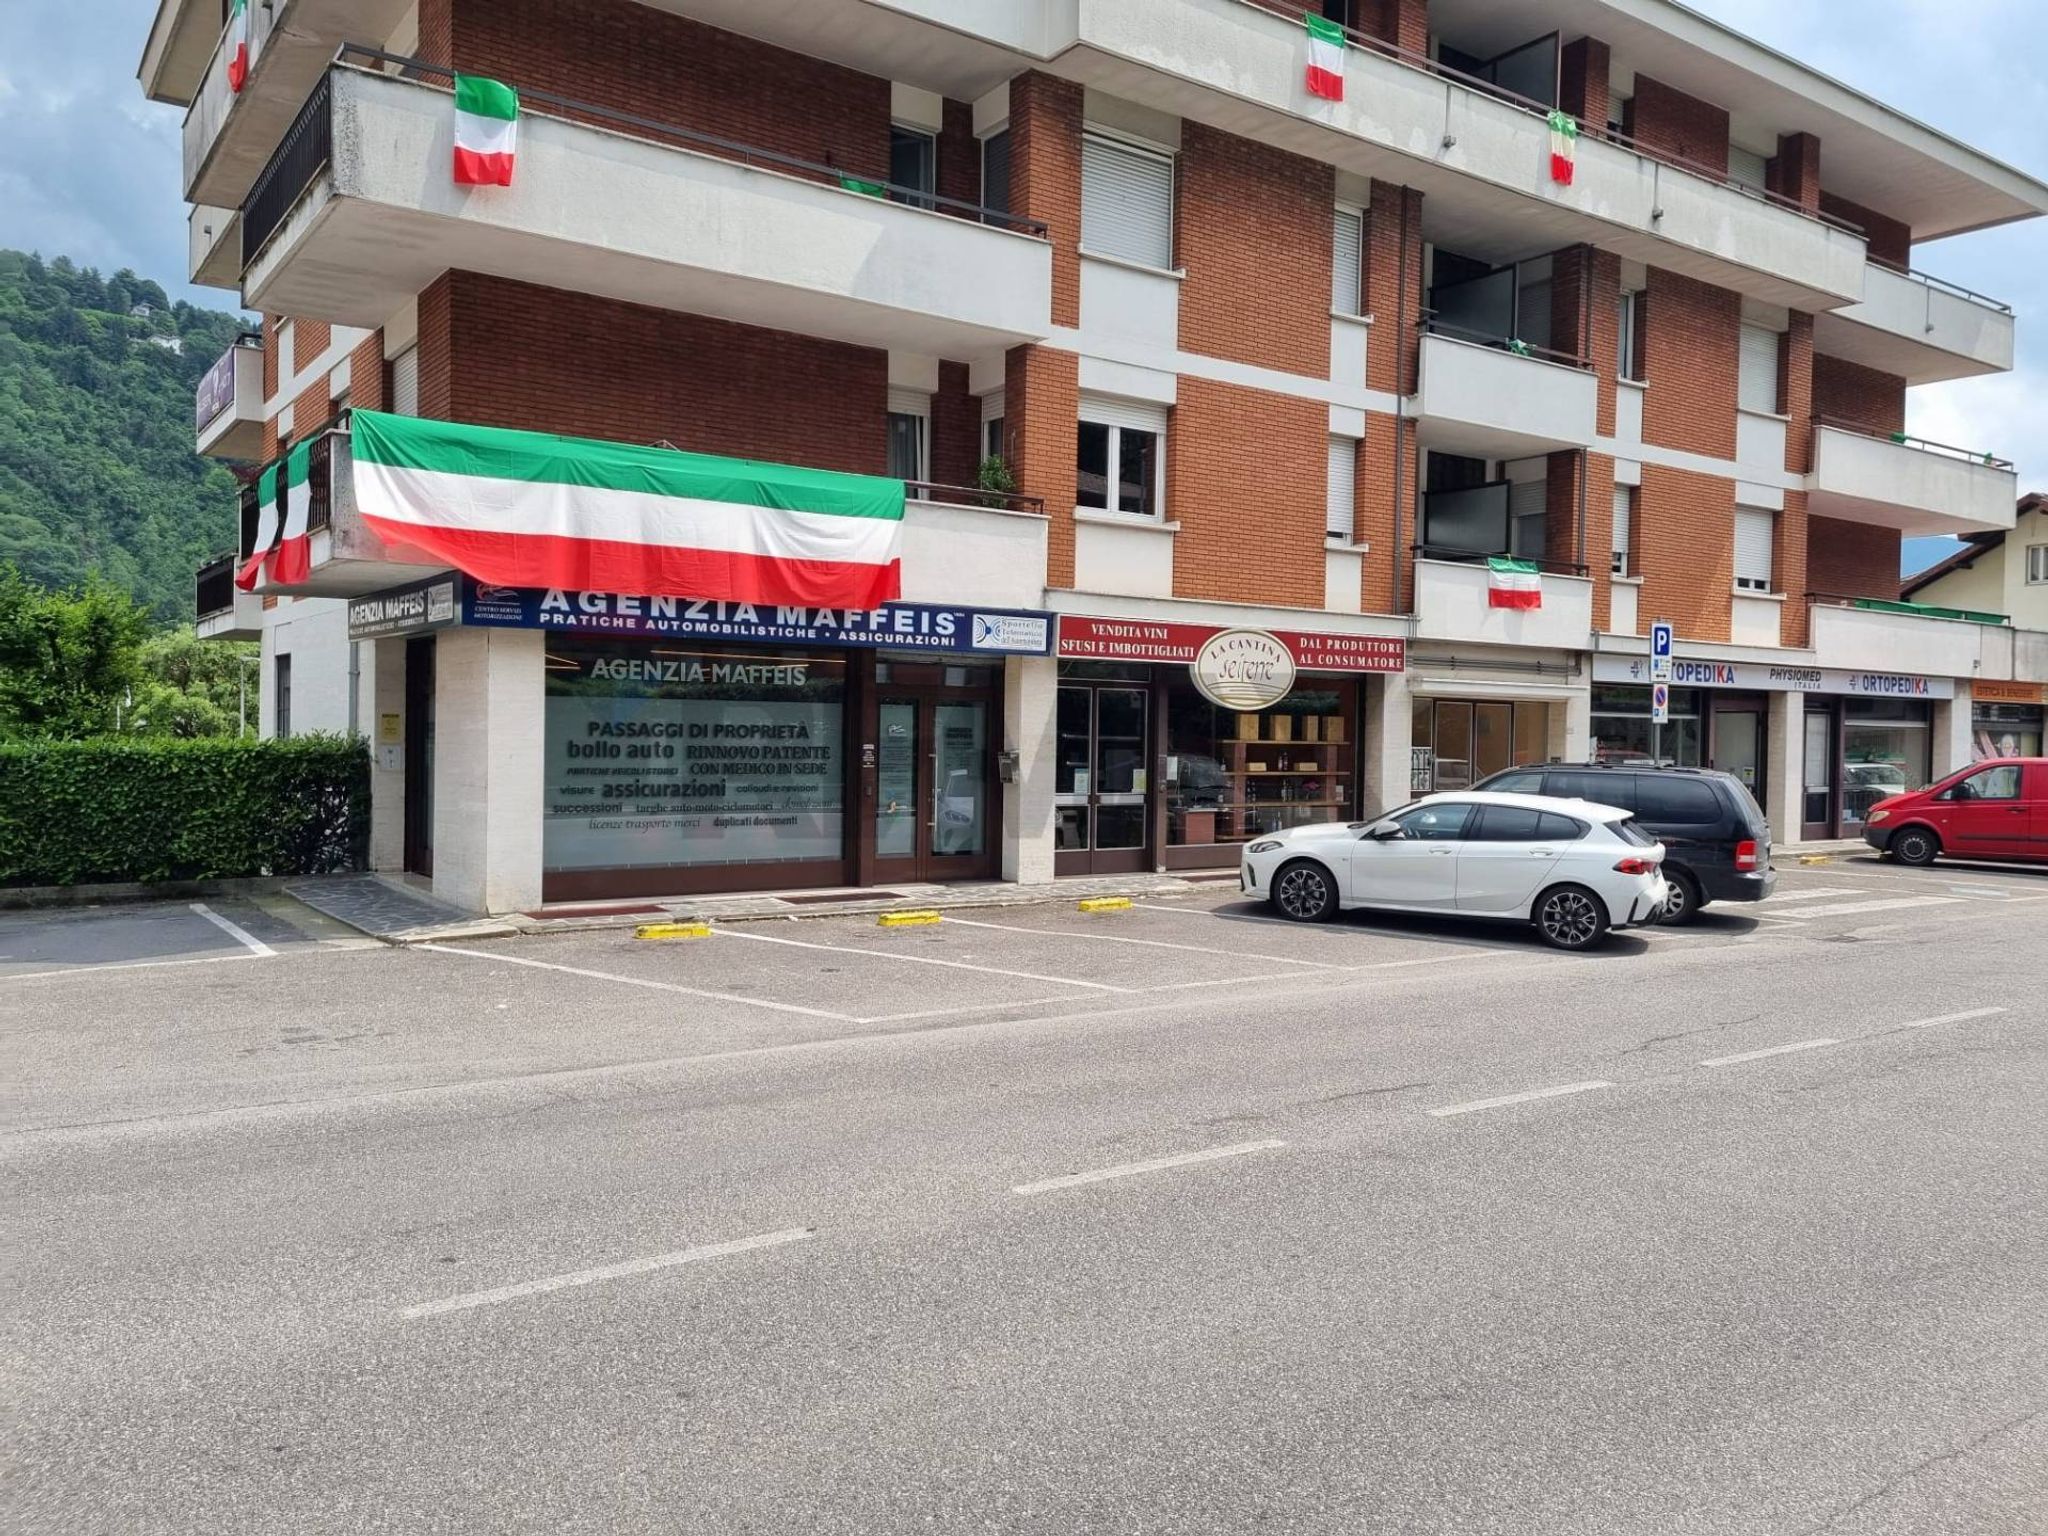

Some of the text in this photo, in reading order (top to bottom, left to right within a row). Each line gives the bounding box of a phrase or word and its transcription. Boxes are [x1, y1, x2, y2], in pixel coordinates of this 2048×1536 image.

[350, 601, 384, 625] AGENZIA
[386, 590, 424, 619] MAFFEIS
[540, 589, 955, 635] AGENZIA MAFFEIS
[540, 613, 955, 647] PRATICHE AUTOMOBILISTICHE ASSICURAZIONI
[1091, 624, 1168, 640] VENDITA VINI
[1061, 639, 1194, 658] SFUSI E IMBOTTIGLIATI
[1300, 637, 1401, 654] DAL PRODUTTORE
[1657, 631, 1667, 652] P
[1210, 639, 1281, 663] LA CANTINA
[1300, 654, 1401, 668] AL CONSUMATORE
[590, 658, 807, 687] AGENZIA MAFFEIS
[1770, 668, 1822, 682] PHYSIOMED
[1794, 682, 1821, 690] ITALIA
[1862, 674, 1928, 694] ORTOPEDIKA
[588, 721, 810, 739] PASSAGGI DI PROPRIETÀ
[567, 740, 674, 759] bollo auto
[686, 746, 830, 760] RINNOVO PATENTE
[690, 762, 828, 775] CON MEDICO IN SEDE
[560, 786, 595, 794] visure
[602, 778, 726, 798] assicurazioni
[553, 802, 622, 813] successioni
[714, 816, 798, 828] duplicati documenti
